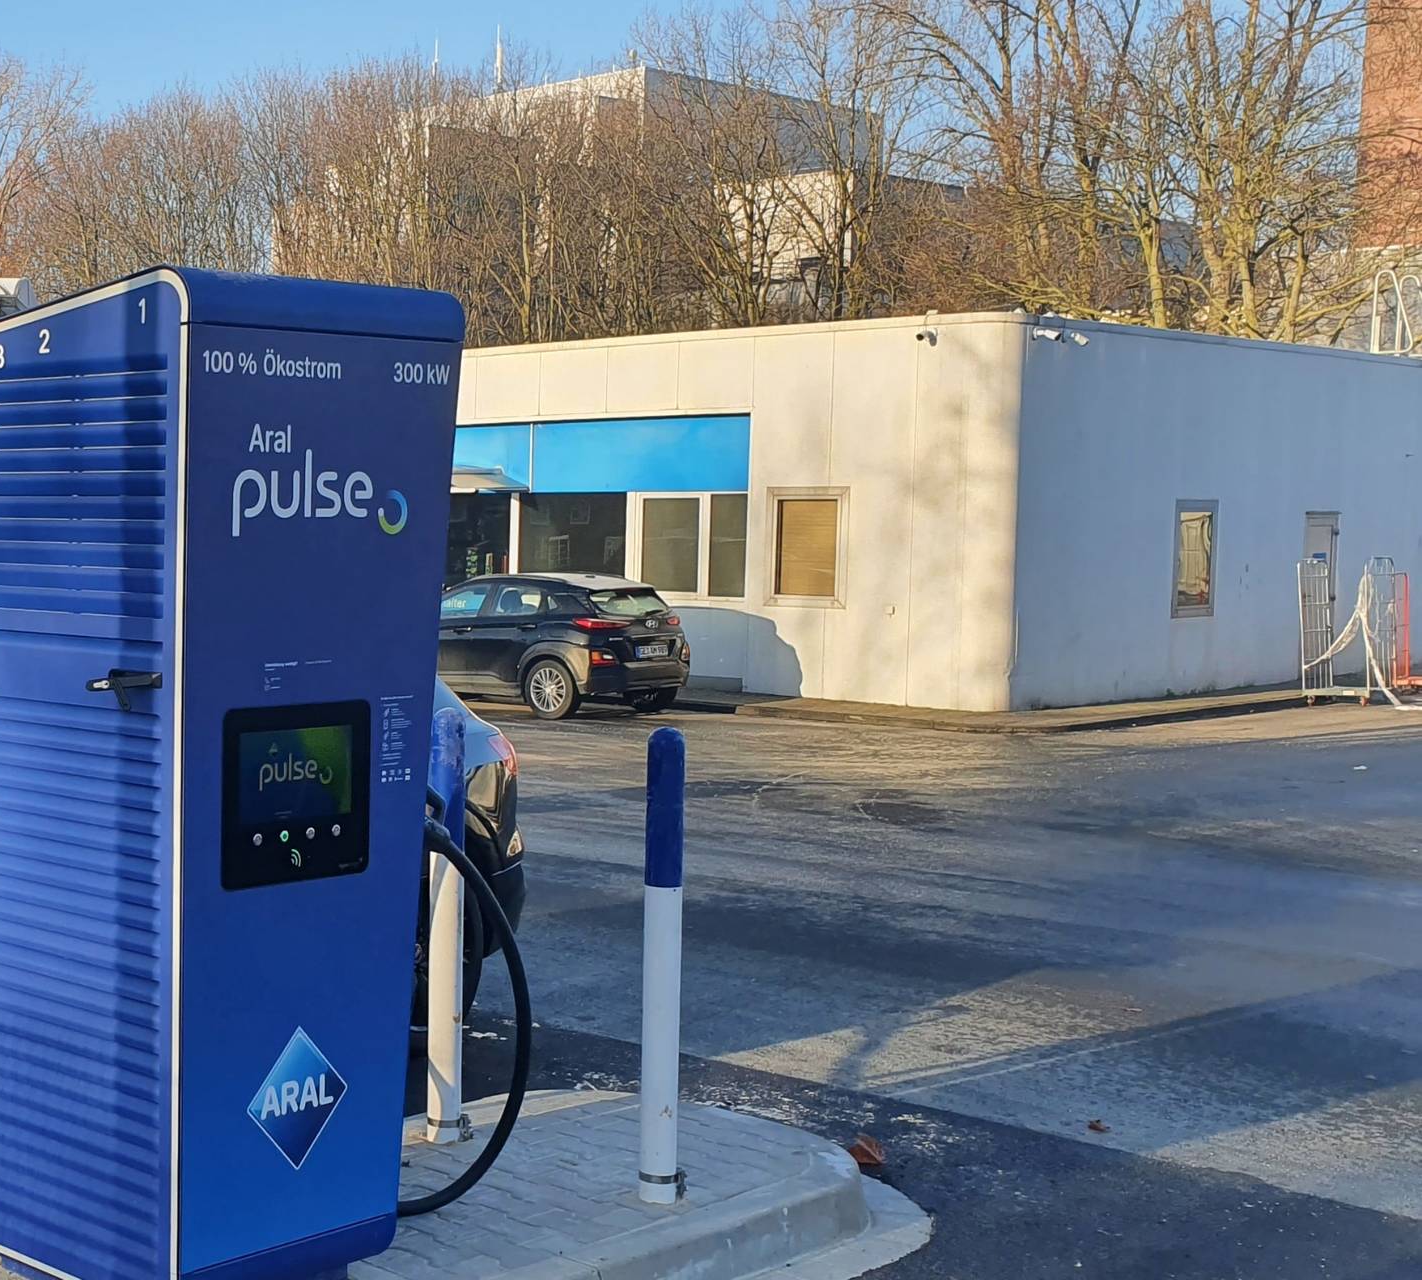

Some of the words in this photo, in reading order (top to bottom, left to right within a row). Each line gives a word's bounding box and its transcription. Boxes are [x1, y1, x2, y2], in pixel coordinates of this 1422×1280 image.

[138, 297, 146, 324] 1
[38, 328, 51, 354] 2
[202, 350, 234, 374] 100
[238, 352, 258, 375] %
[263, 348, 342, 380] Ökostrom
[393, 362, 424, 384] 300
[427, 364, 451, 385] kW
[248, 423, 292, 454] Aral
[231, 449, 374, 537] pulse
[258, 752, 318, 791] pulse
[260, 1073, 335, 1121] ARAL
